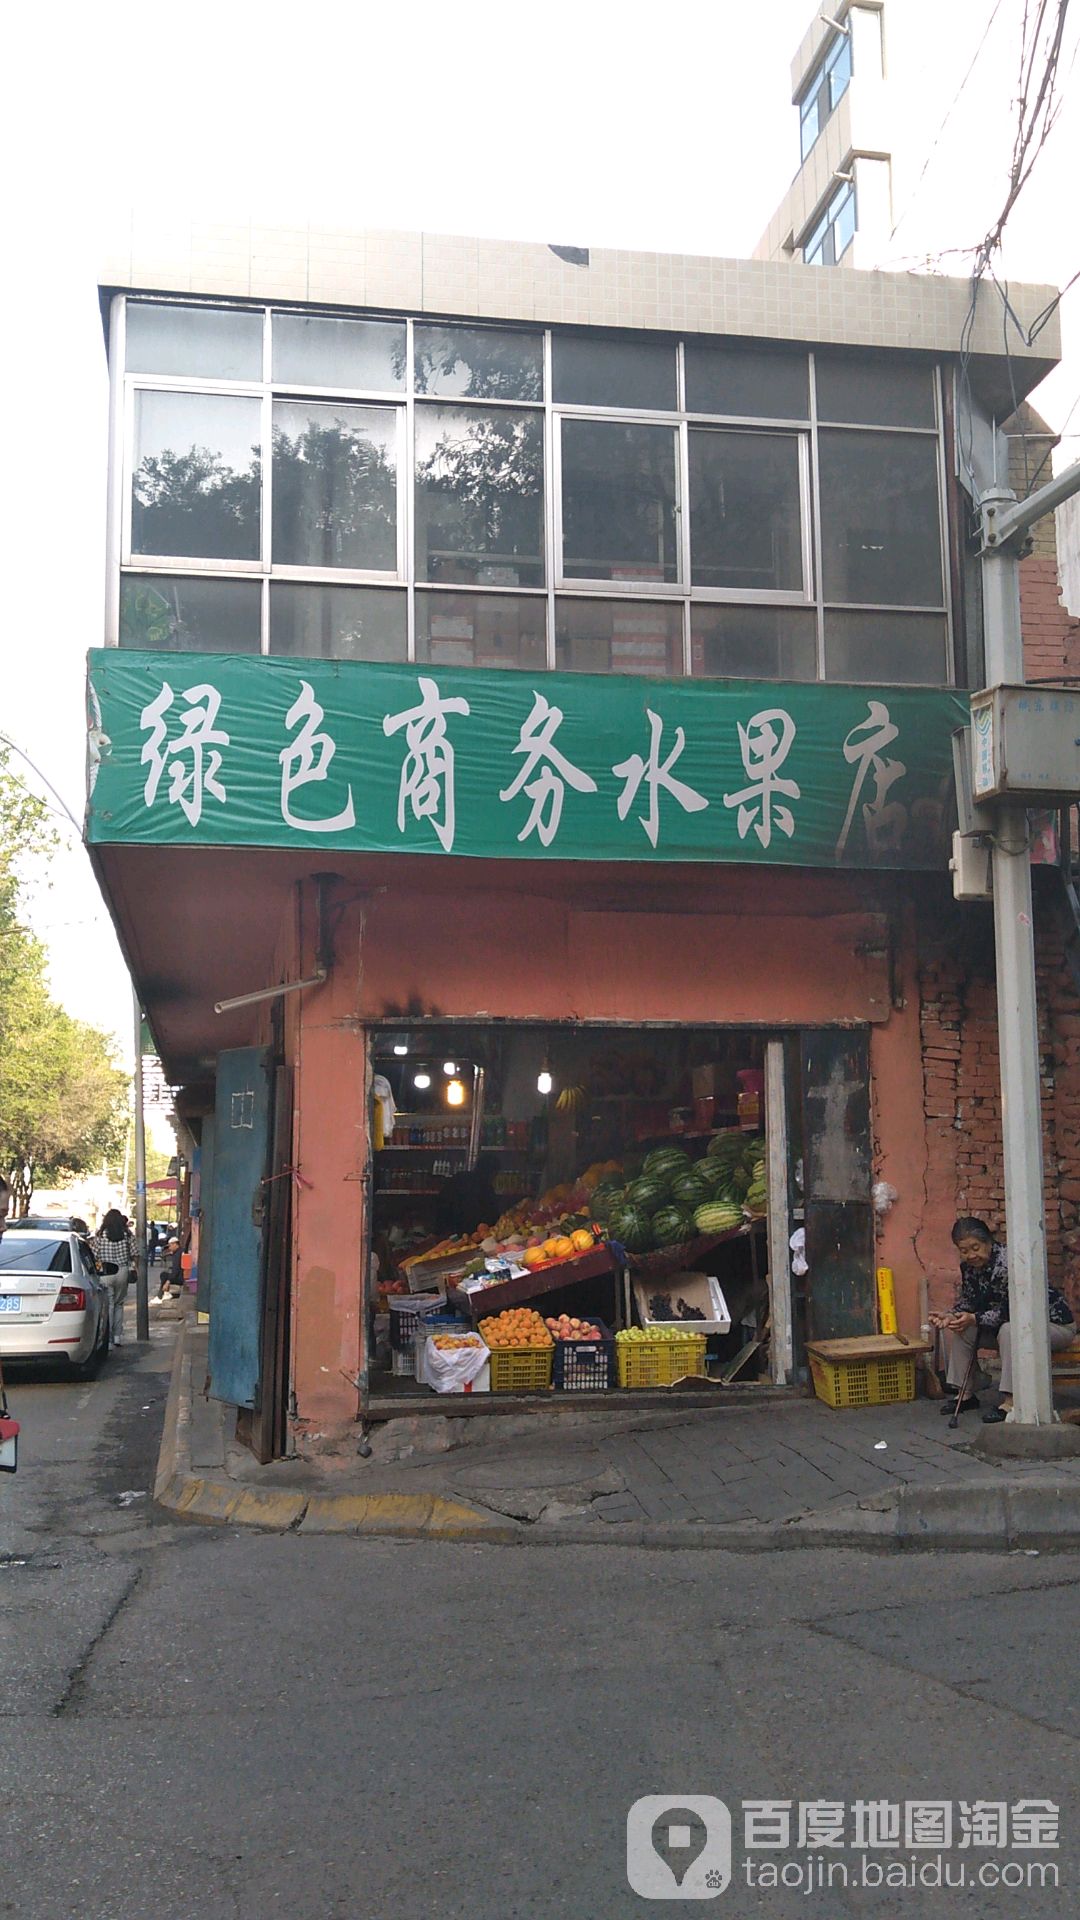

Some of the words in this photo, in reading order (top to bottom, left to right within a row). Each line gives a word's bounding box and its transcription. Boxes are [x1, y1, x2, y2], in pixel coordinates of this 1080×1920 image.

[139, 676, 907, 864] 绿色商务水果店
